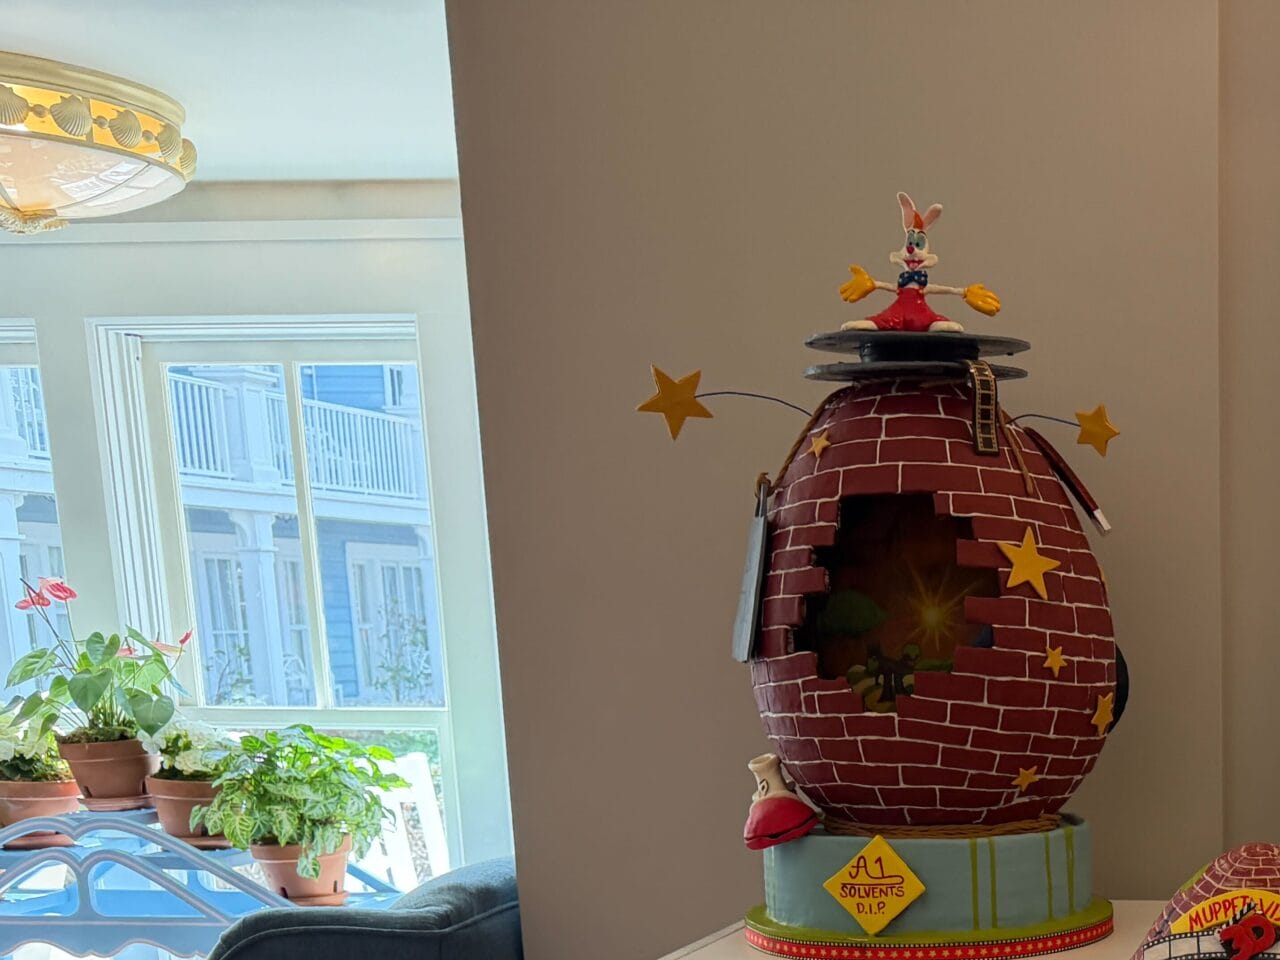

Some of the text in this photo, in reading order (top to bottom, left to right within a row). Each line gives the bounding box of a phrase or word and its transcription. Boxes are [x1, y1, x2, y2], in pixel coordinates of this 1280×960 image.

[840, 885, 905, 898] SOLVENTS
[856, 901, 886, 915] D.I.P.
[1188, 895, 1250, 932] MUPPET
